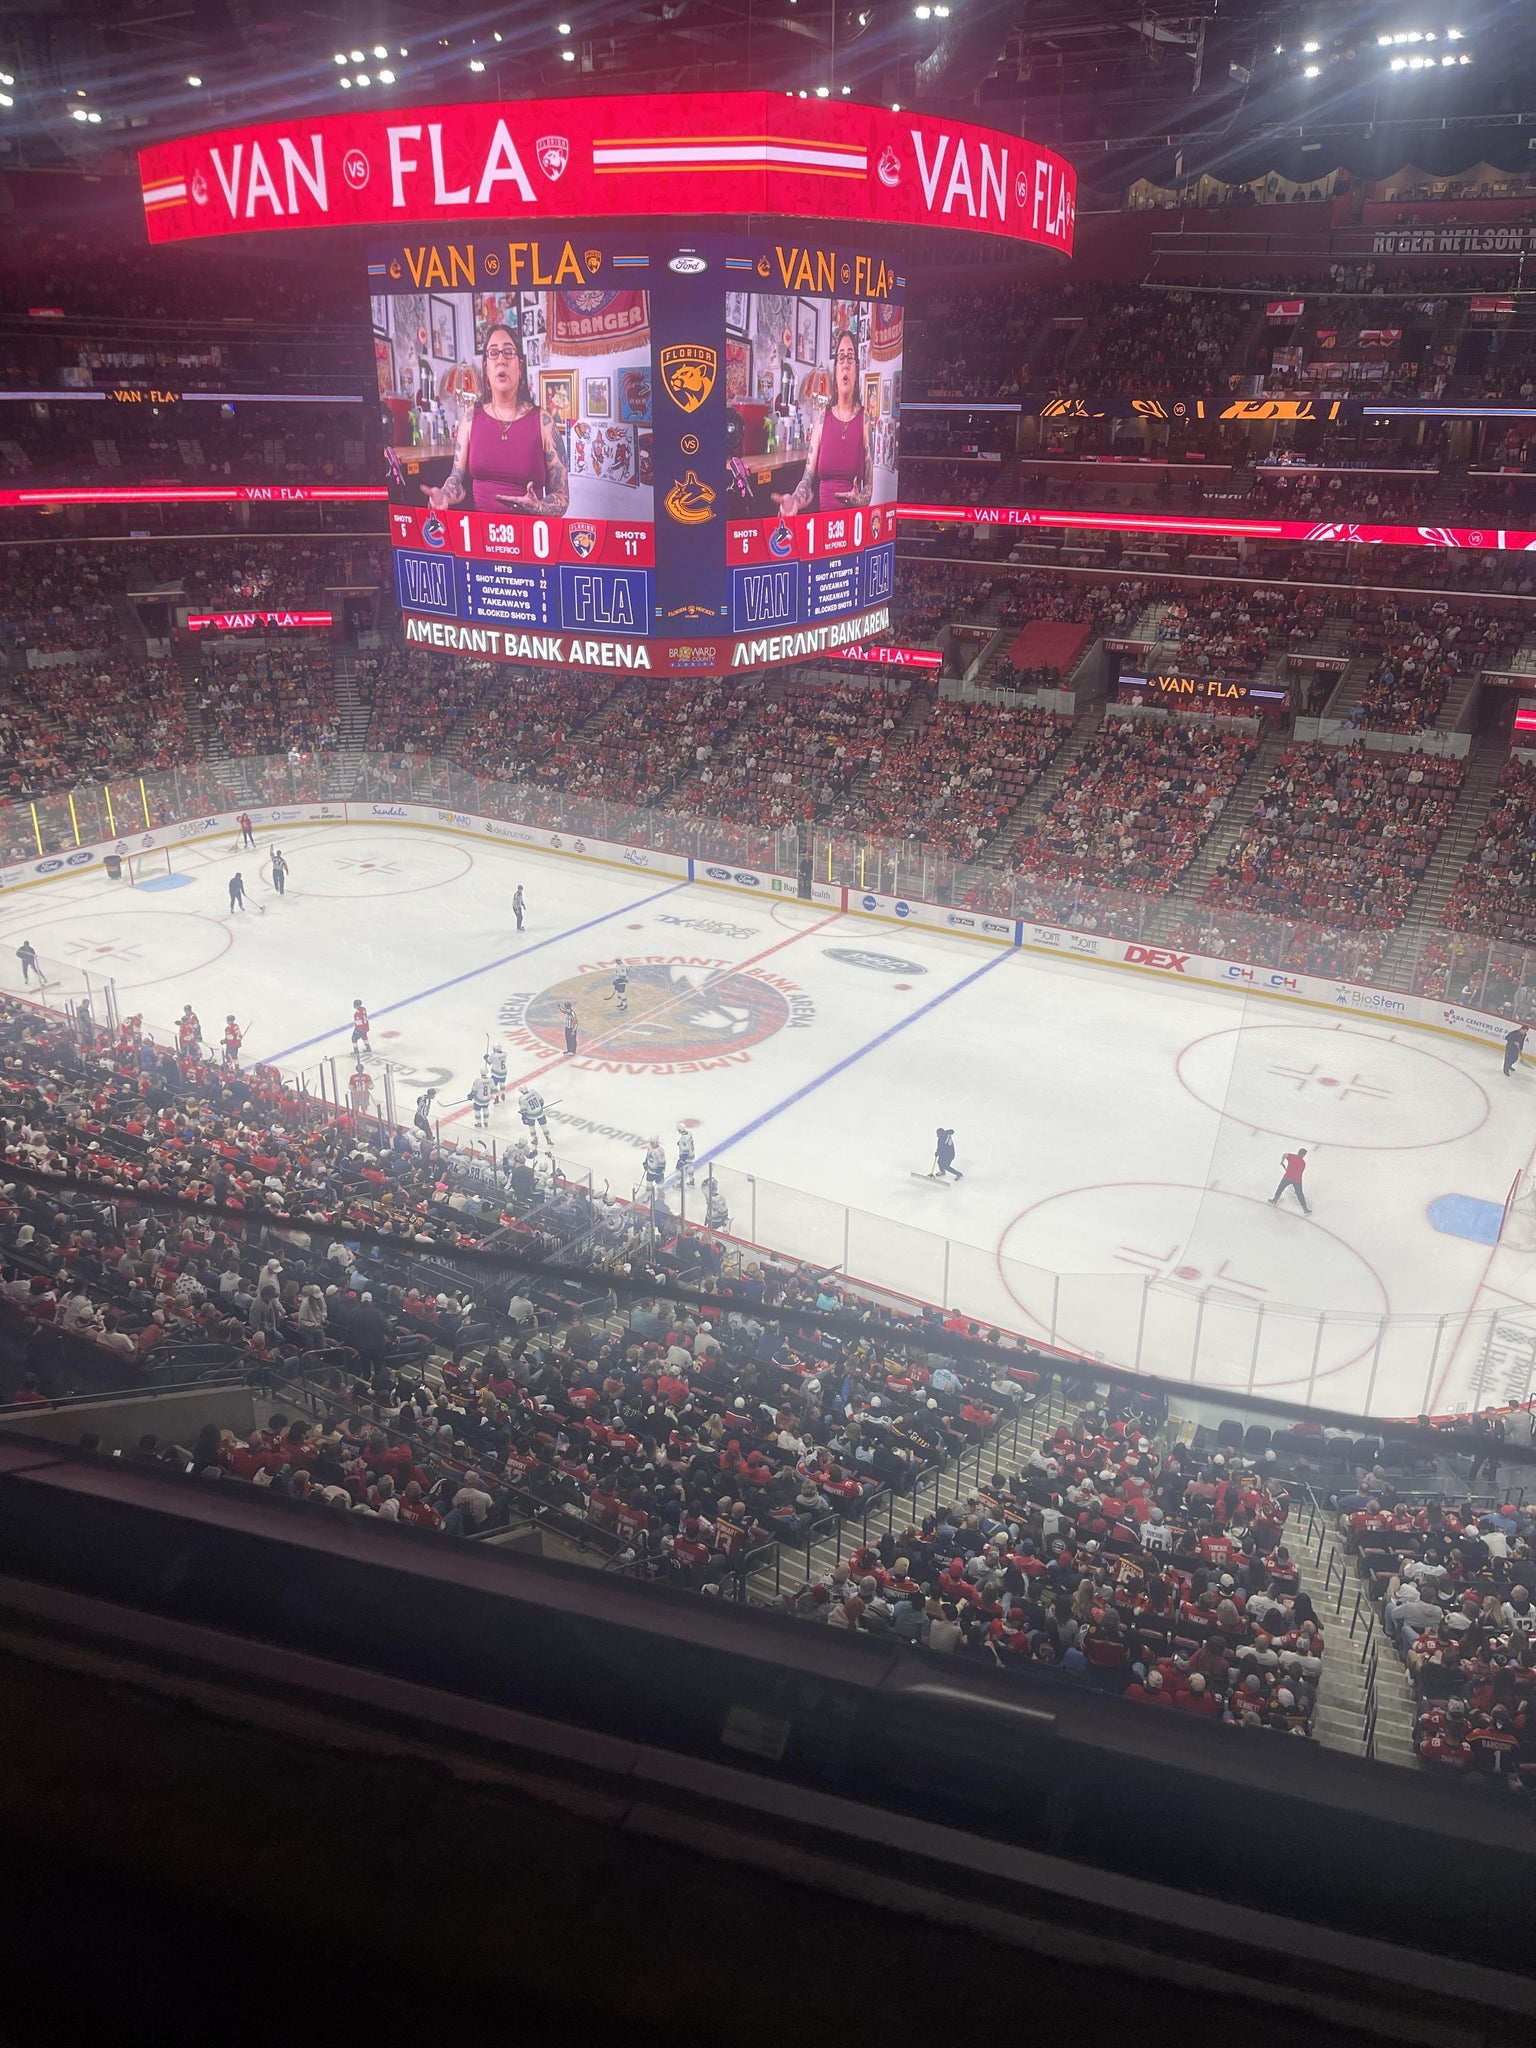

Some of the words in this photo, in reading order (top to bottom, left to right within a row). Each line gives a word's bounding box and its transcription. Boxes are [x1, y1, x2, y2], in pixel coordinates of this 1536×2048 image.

[209, 133, 328, 220] VAN
[347, 161, 366, 178] VS
[386, 118, 538, 208] FLA
[911, 130, 1008, 221] VAN
[1017, 182, 1027, 196] VS
[1032, 160, 1066, 240] FLA
[1373, 231, 1435, 252] ROGER
[1440, 228, 1523, 250] NEILSON
[404, 244, 477, 288] VAN
[487, 259, 498, 270] VS
[509, 240, 586, 286] FLA
[776, 247, 835, 292] VAN
[843, 268, 850, 279] VS
[855, 256, 887, 298] FLA
[666, 349, 711, 361] FLORIDA
[113, 390, 141, 402] VAN
[150, 390, 175, 402] FLA
[684, 440, 696, 448] VS
[245, 488, 271, 499] VAN
[280, 488, 304, 499] FLA
[394, 515, 412, 523] SHOTS
[974, 509, 999, 521] VAN
[1009, 511, 1031, 523] FLA
[401, 524, 406, 537] 5
[460, 516, 471, 552] 1
[488, 523, 514, 543] 5:39
[533, 520, 549, 558] 0
[615, 530, 646, 540] SHOTS
[734, 529, 758, 539] SHOTS
[806, 517, 815, 554] 1
[828, 520, 844, 539] 5:39
[854, 511, 863, 547] 0
[1471, 534, 1481, 543] VS
[494, 546, 520, 554] PERIOD
[625, 541, 637, 556] 11
[742, 539, 749, 554] 5
[494, 565, 513, 574] HITS
[829, 559, 842, 568] HITS
[475, 575, 494, 584] SHOT
[495, 577, 535, 587] ATTEMPTS
[815, 573, 829, 582] SHOT
[829, 568, 853, 580] ATTEMPTS
[870, 552, 889, 597] FLA
[405, 559, 447, 606] VAN
[820, 579, 849, 592] GIVEAWAYS
[482, 586, 529, 598] GIVEAWAYS
[743, 572, 789, 622] VAN
[819, 590, 850, 603] TAKEAWAYS
[481, 597, 531, 609] TAKEAWAYS
[574, 575, 634, 624] FLA
[477, 608, 510, 618] BLOCKED
[511, 611, 537, 621] SHOTS
[815, 604, 837, 615] BLOCKED
[838, 600, 852, 610] SHOTS
[224, 614, 254, 627] VAN
[407, 618, 500, 654] AMERANT
[504, 632, 565, 662] BANK
[568, 640, 651, 670] ARENA
[732, 628, 829, 668] AMERANT
[831, 620, 862, 647] BANK
[862, 607, 889, 638] ARENA
[880, 648, 904, 663] FLA
[1158, 676, 1194, 694] VAN
[1207, 681, 1239, 699] FLA
[372, 805, 407, 817] Sandals
[1123, 945, 1191, 973] DEX
[745, 967, 805, 993] BANK
[786, 993, 816, 1028] ARENA
[1352, 991, 1405, 1012] BioStem
[499, 992, 536, 1026] ARENA
[1452, 1014, 1465, 1022] ABA
[1466, 1018, 1493, 1031] CENTERS
[503, 1028, 561, 1059] BANK
[500, 1060, 506, 1070] 6
[483, 1086, 489, 1096] 8
[528, 1096, 539, 1110] 90
[545, 1109, 648, 1148] AutoNatio
